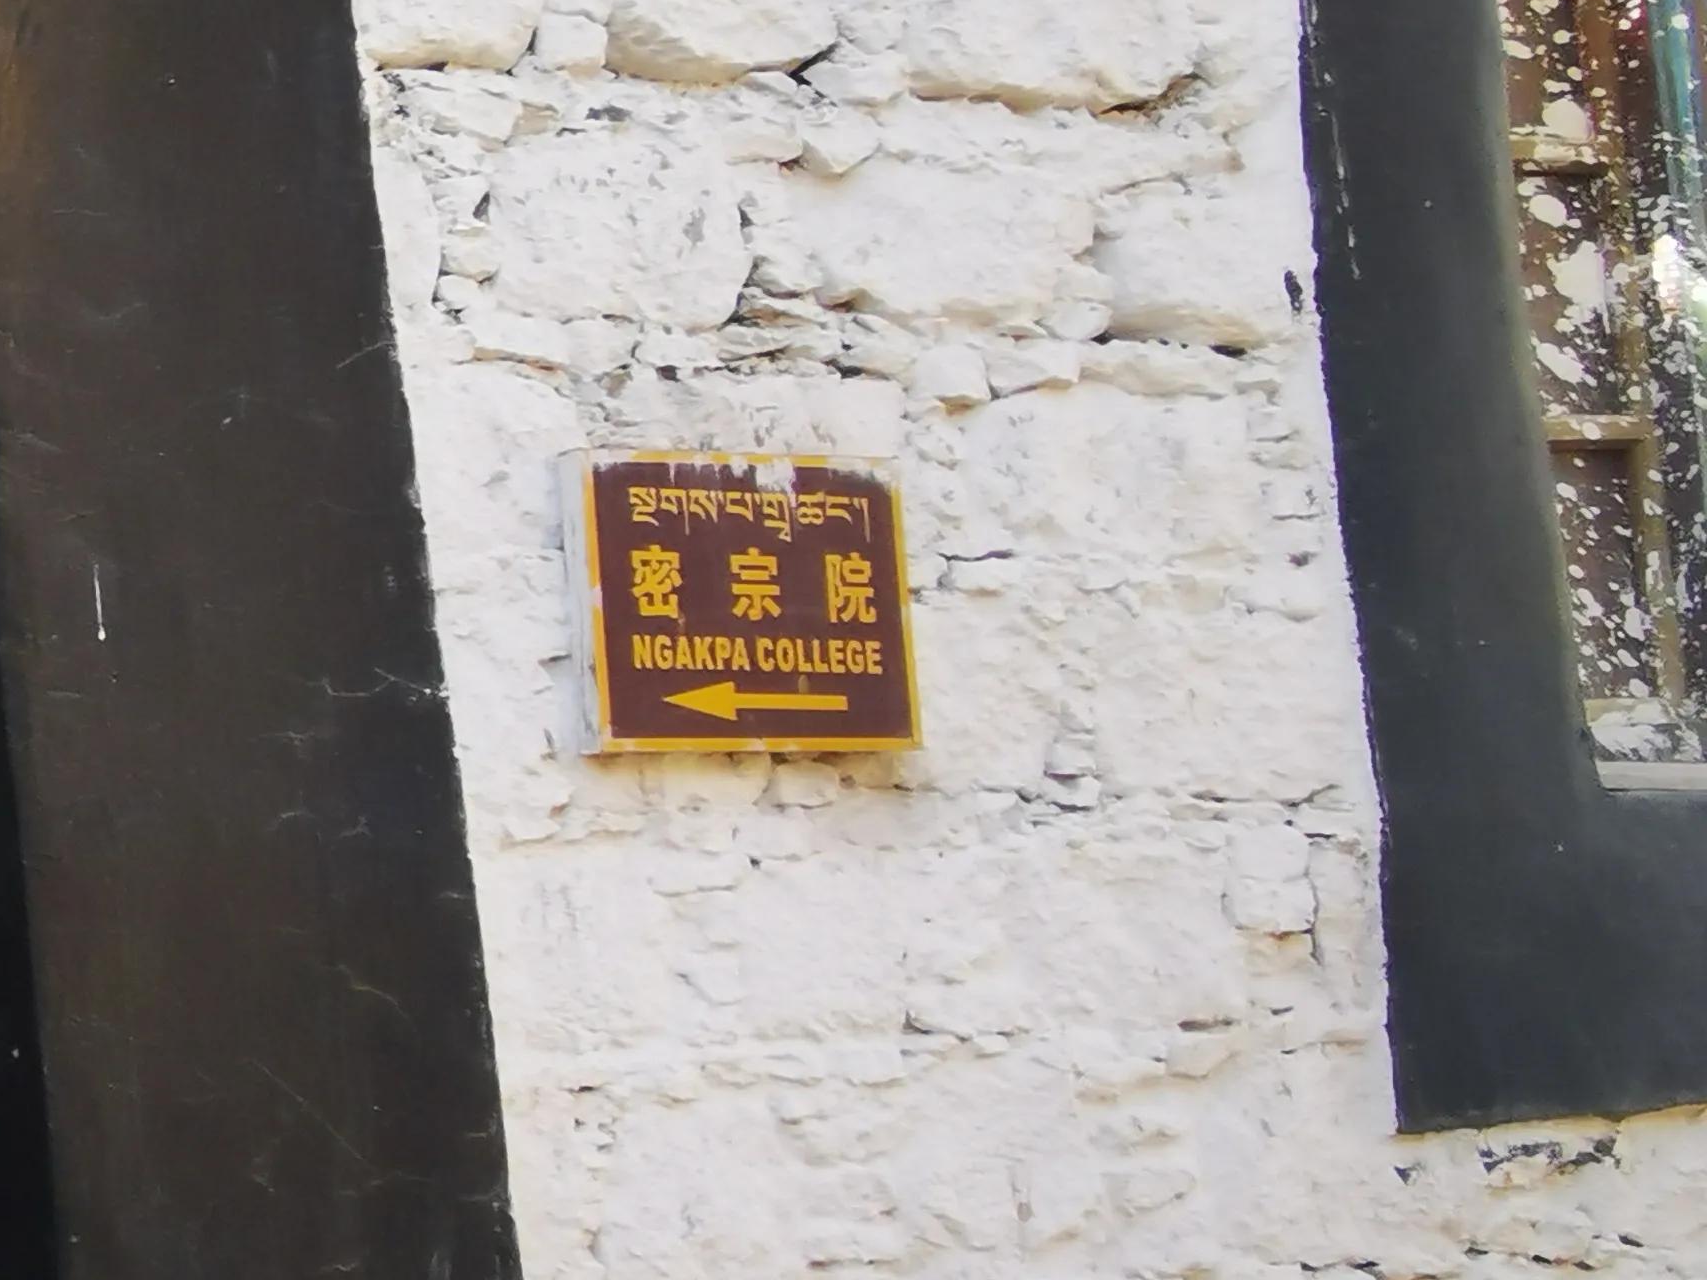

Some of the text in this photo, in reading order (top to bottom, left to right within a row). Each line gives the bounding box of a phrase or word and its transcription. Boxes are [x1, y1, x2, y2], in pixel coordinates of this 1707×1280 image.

[631, 545, 878, 623] 密宗院
[631, 634, 883, 675] NGAKPA COLLEGE
